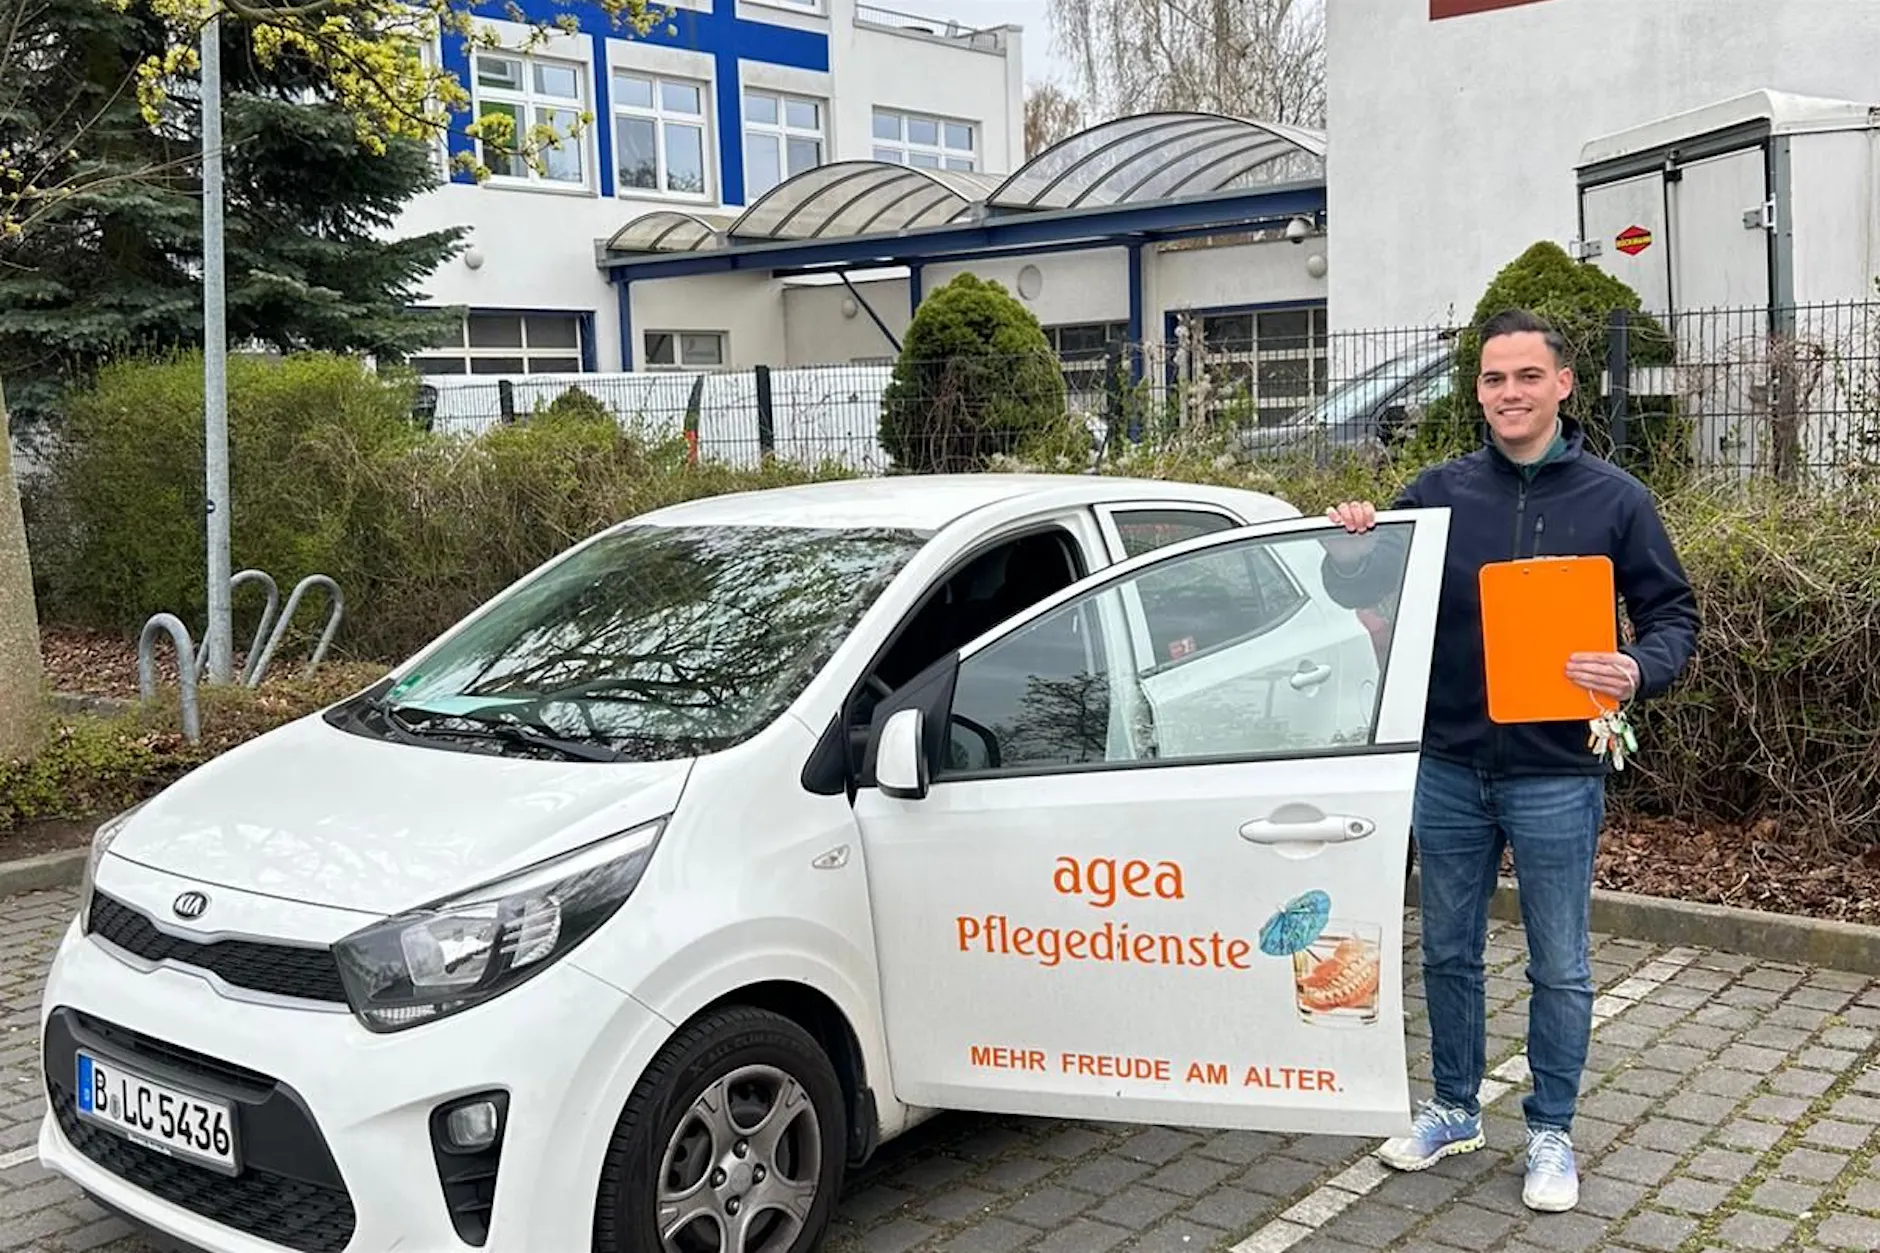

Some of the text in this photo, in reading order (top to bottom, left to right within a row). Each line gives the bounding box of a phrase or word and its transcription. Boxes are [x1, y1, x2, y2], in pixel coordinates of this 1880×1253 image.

[175, 894, 203, 915] KIA
[1053, 856, 1185, 908] agea
[956, 914, 1252, 969] Pflegedienste
[969, 1045, 1345, 1093] MEHR FREUDE AM ALTER.
[94, 1067, 108, 1112] B
[122, 1078, 154, 1131] LC
[158, 1092, 230, 1156] 5436
